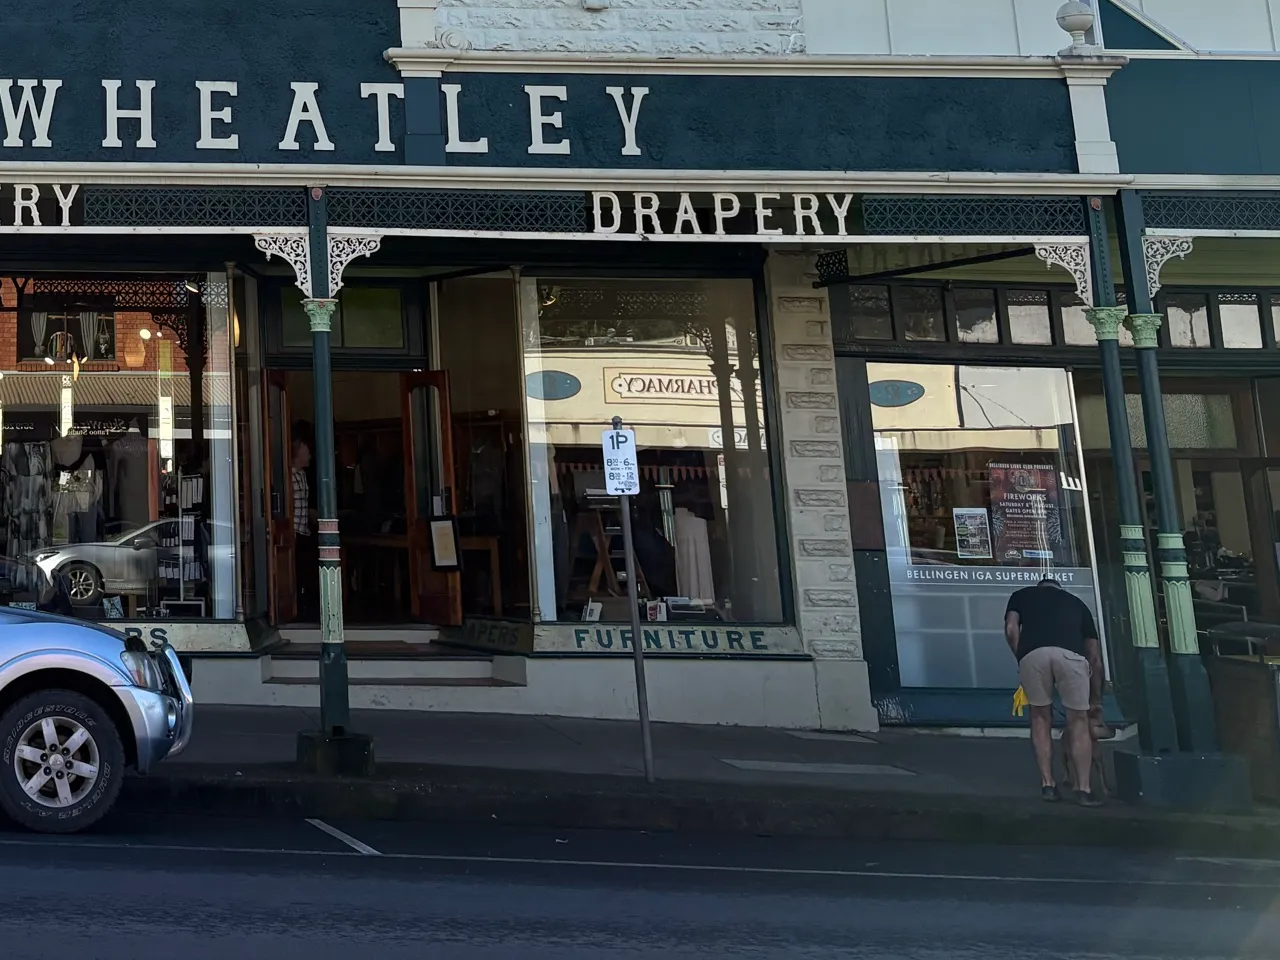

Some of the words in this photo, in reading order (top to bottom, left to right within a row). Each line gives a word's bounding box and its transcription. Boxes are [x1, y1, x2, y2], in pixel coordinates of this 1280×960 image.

[592, 190, 855, 236] DRAPERY
[609, 434, 628, 450] 1P
[907, 570, 968, 580] BELLINGEN
[972, 571, 993, 580] IGA
[996, 571, 1075, 582] SUPERMARKET
